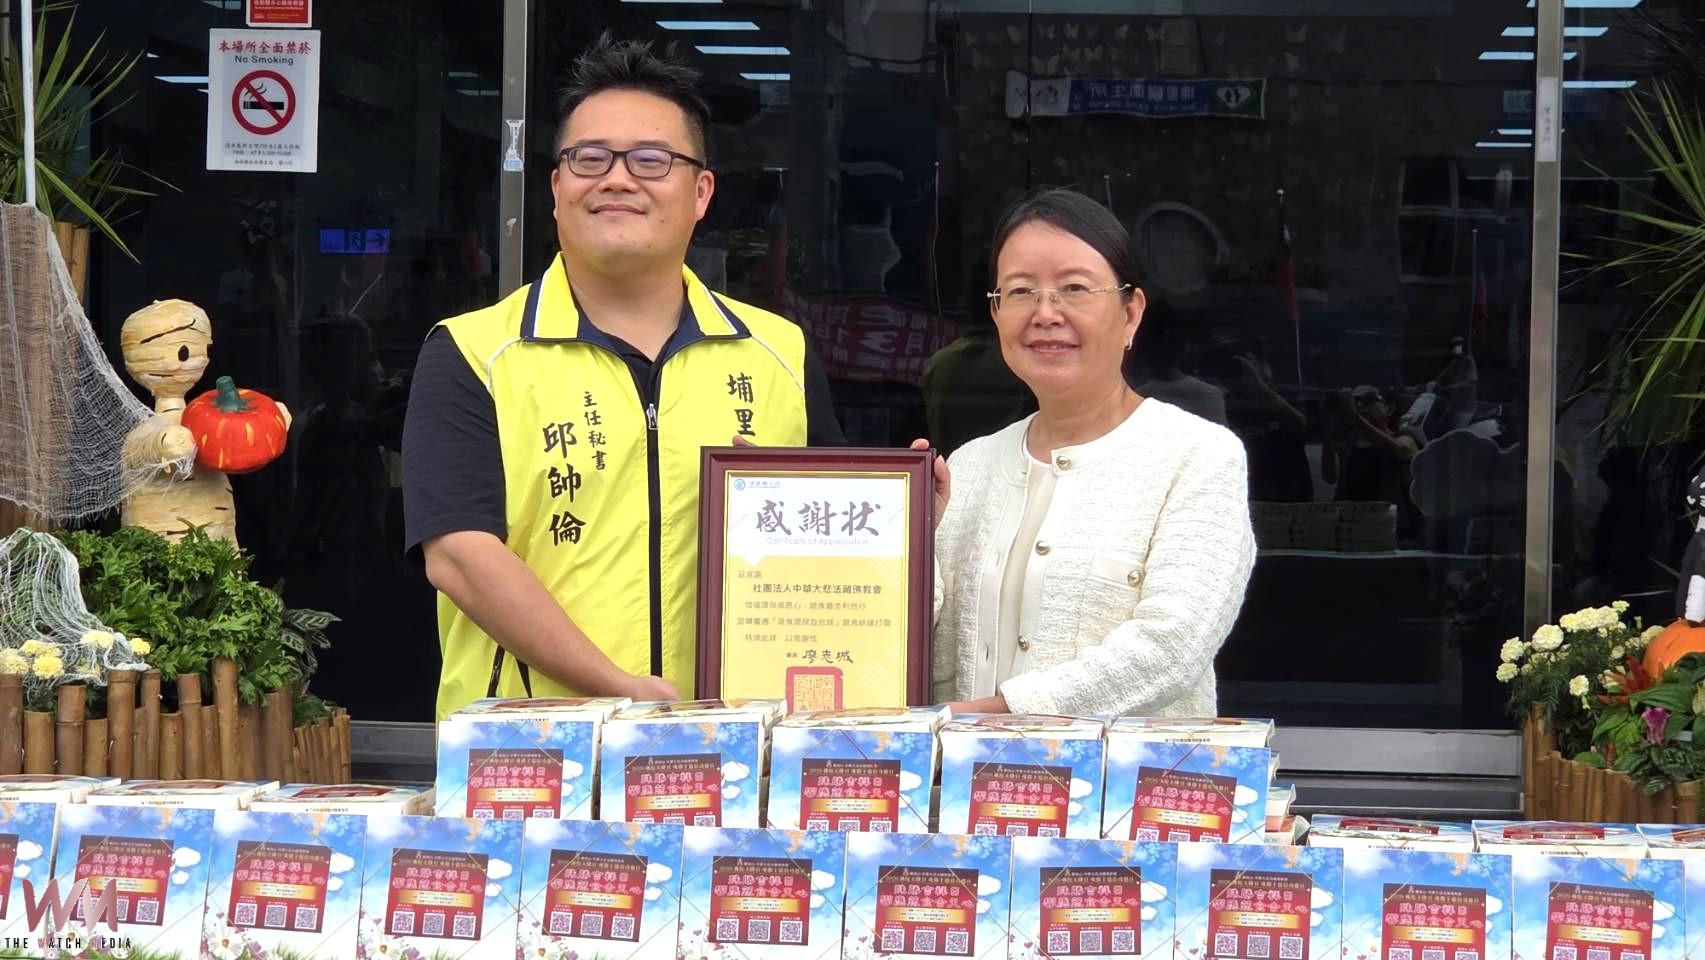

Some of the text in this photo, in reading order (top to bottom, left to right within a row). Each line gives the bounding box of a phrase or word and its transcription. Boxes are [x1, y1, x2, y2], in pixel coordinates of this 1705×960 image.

[218, 40, 312, 55] 本場所全面禁菸
[235, 55, 294, 65] No Smoking
[583, 391, 607, 471] 主任秘書
[726, 372, 756, 437] 埔里
[542, 421, 586, 546] 邱帥倫
